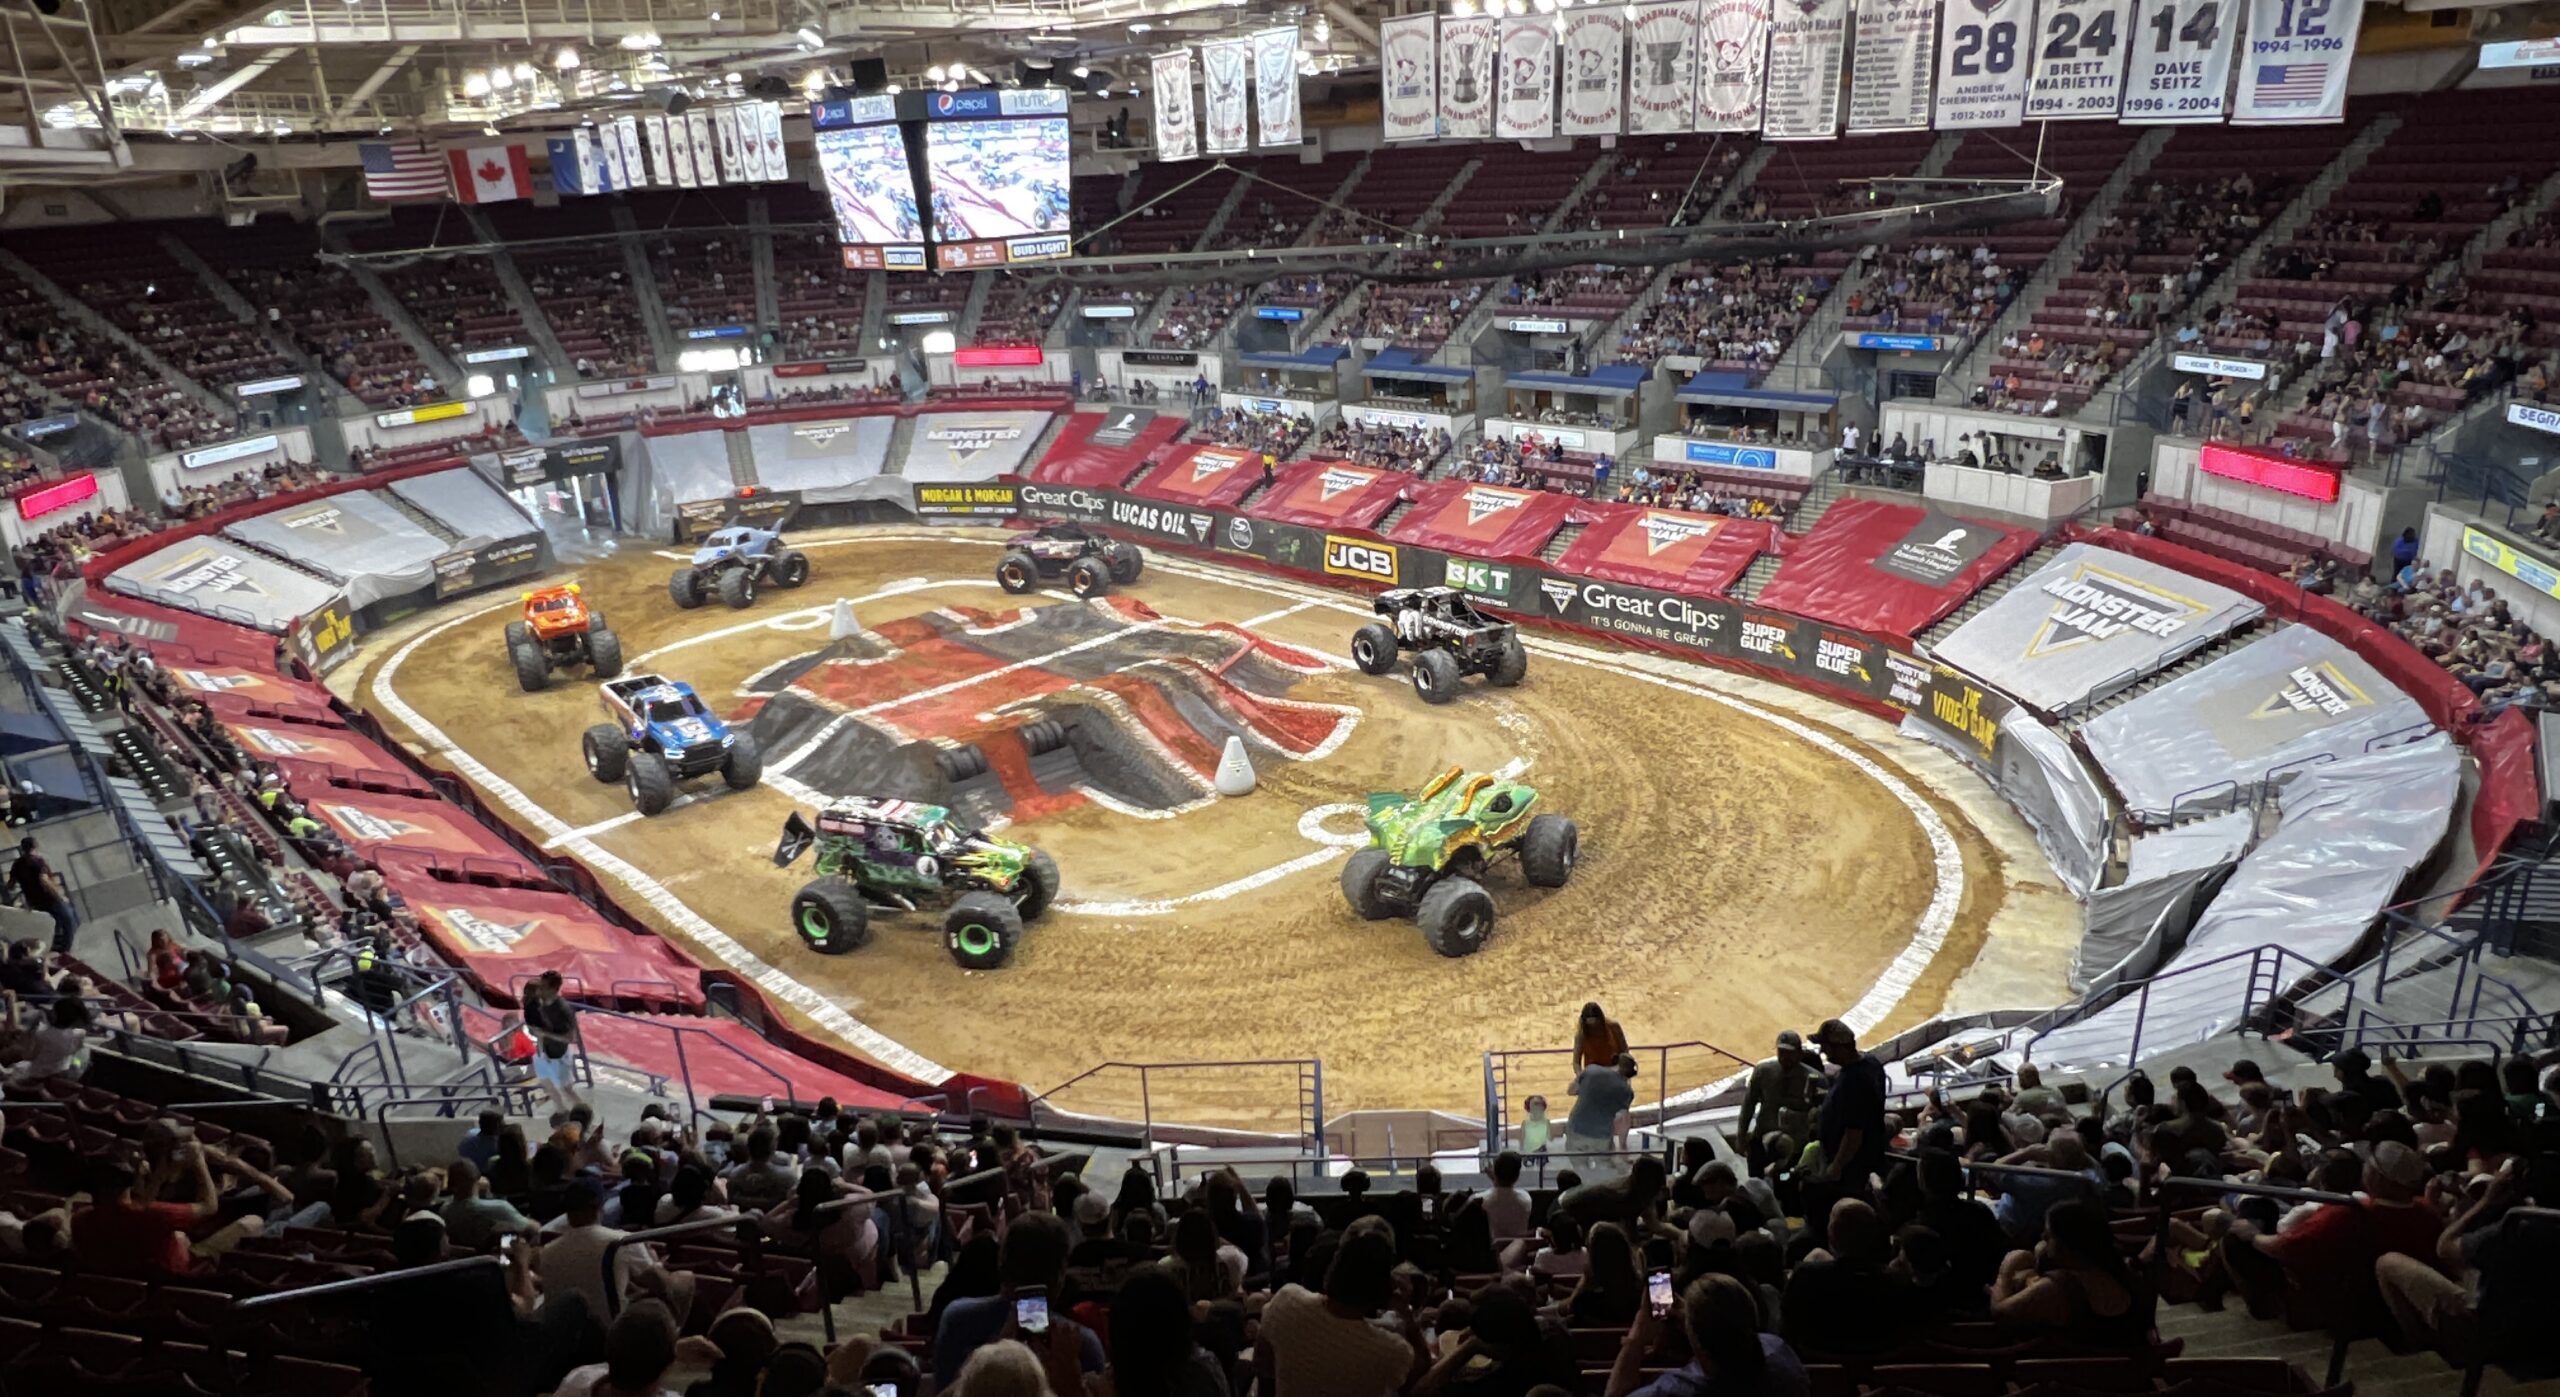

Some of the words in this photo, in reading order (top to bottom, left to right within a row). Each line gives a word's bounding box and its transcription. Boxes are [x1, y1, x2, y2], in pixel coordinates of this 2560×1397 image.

[1679, 12, 1698, 26] CUP
[2150, 2, 2219, 53] 14
[2275, 0, 2326, 37] 12
[2042, 10, 2117, 59] 24
[1952, 21, 2017, 76] 28
[2050, 61, 2103, 76] BRETT
[2155, 61, 2201, 76] DAVE
[1956, 83, 2005, 95] ANDREW
[2036, 76, 2114, 91] MARIETTI
[2150, 76, 2202, 90] SEITZ
[956, 97, 988, 113] pepsi
[2029, 98, 2063, 112] 1994
[2076, 96, 2115, 110] 2003
[2126, 98, 2164, 111] 1996
[2180, 97, 2220, 111] 2004
[1013, 244, 1035, 256] BUD
[1036, 241, 1066, 254] LIGHT
[927, 429, 1021, 440] MONSTER
[948, 440, 992, 450] JAM
[921, 488, 963, 503] MORGAN
[965, 489, 972, 502] &
[974, 489, 1014, 503] MORGAN
[1021, 486, 1067, 507] Great
[1070, 490, 1106, 513] Clips
[1112, 500, 1158, 530] LUCAS
[1161, 511, 1186, 535] OIL
[1637, 518, 1710, 536] MONSTER
[1650, 530, 1687, 542] JAM
[1329, 546, 1391, 576] JCB
[1446, 562, 1509, 591] BKT
[1583, 584, 1654, 618] Great
[1658, 598, 1721, 632] Clips
[2042, 576, 2186, 638] MONSTER
[1590, 615, 1610, 628] IT'S
[1613, 618, 1653, 636] GONNA
[1656, 627, 1670, 640] BE
[1674, 631, 1712, 648] GREAT
[1742, 621, 1786, 643] SUPER
[2050, 607, 2123, 640] JAM
[1740, 635, 1774, 654] GLUE
[1818, 639, 1861, 664] SUPER
[1815, 653, 1850, 675] GLUE
[1885, 658, 1931, 684] MONSTER
[1963, 685, 1982, 713] THE
[2281, 690, 2318, 712] JAM
[2289, 666, 2351, 717] MONSTER
[1933, 690, 1968, 732] VIDEO
